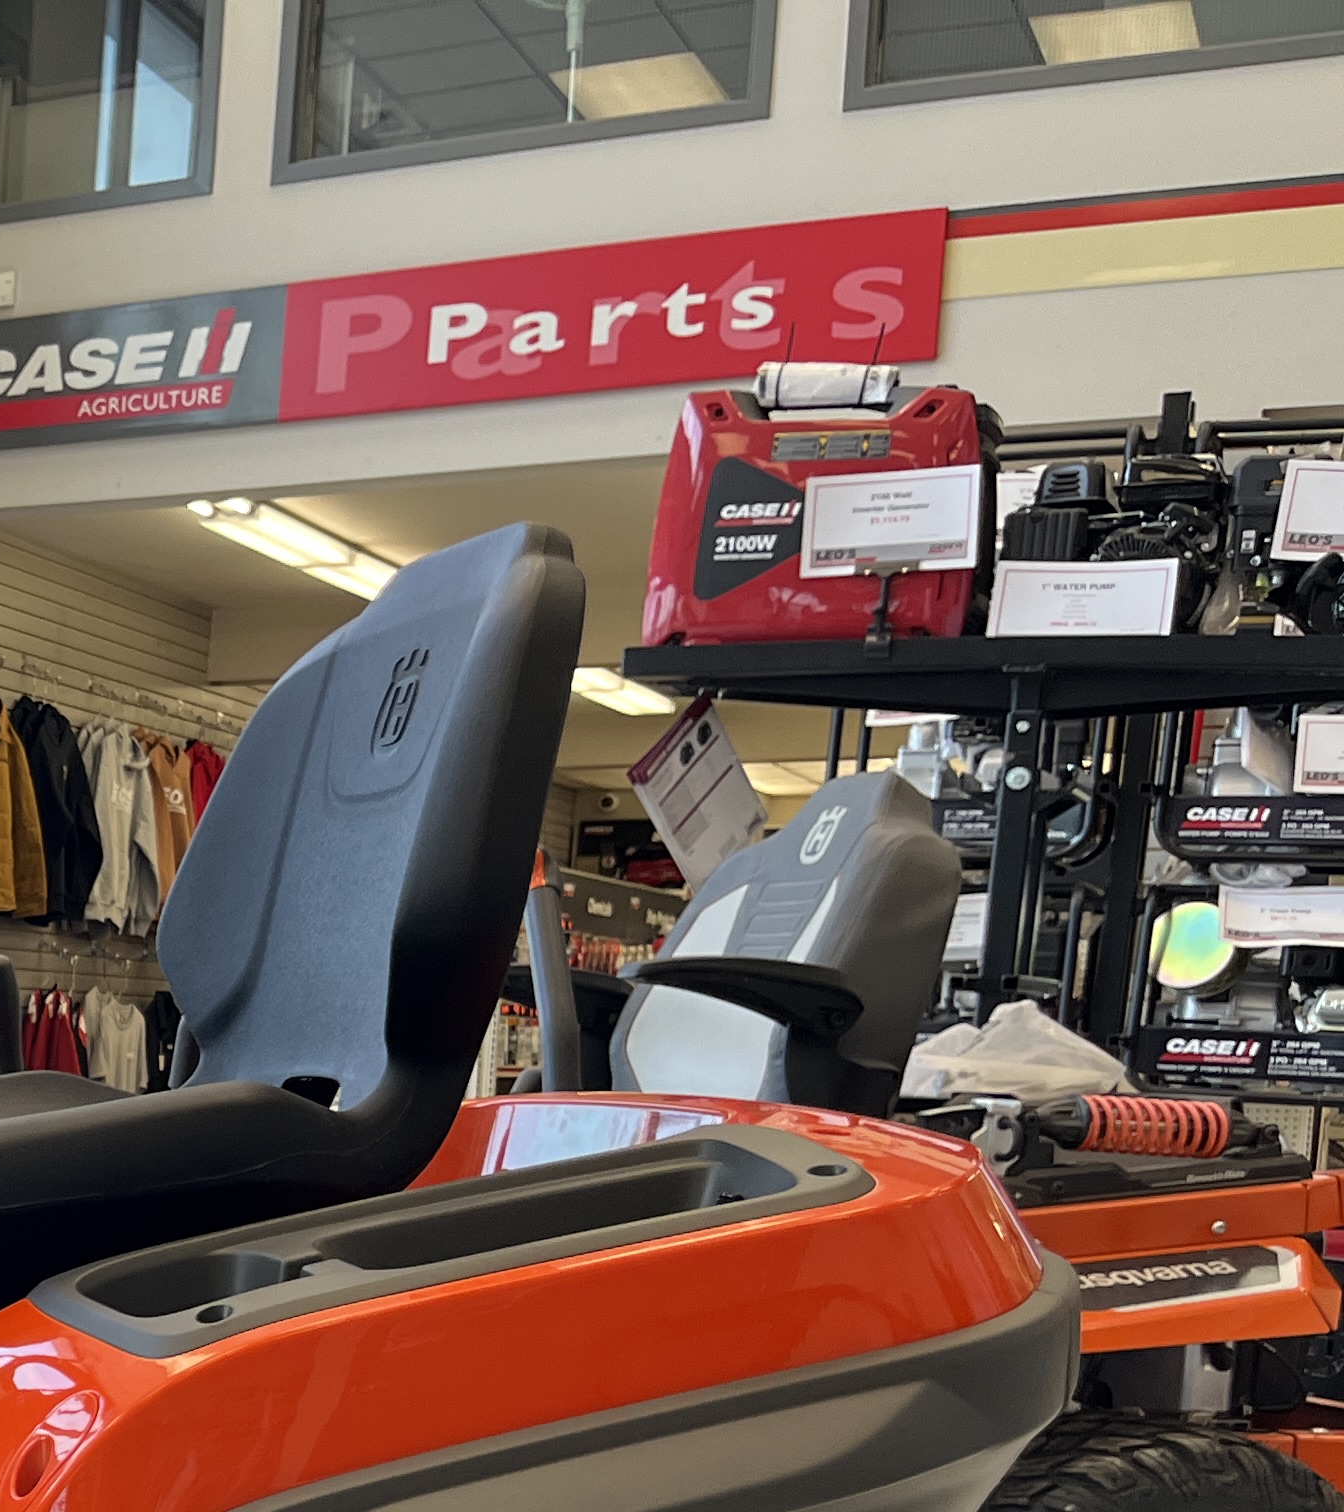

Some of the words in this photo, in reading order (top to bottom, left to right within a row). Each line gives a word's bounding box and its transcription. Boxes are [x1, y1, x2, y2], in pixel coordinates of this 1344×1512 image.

[426, 282, 775, 364] Parts
[77, 384, 224, 418] AGRICULTURE
[720, 503, 781, 520] CASE
[714, 534, 778, 553] 2100W
[1288, 533, 1333, 546] LEO'S
[1186, 806, 1249, 821] CASE
[1165, 1037, 1237, 1055] CASE
[1079, 1257, 1238, 1287] usqvarna
